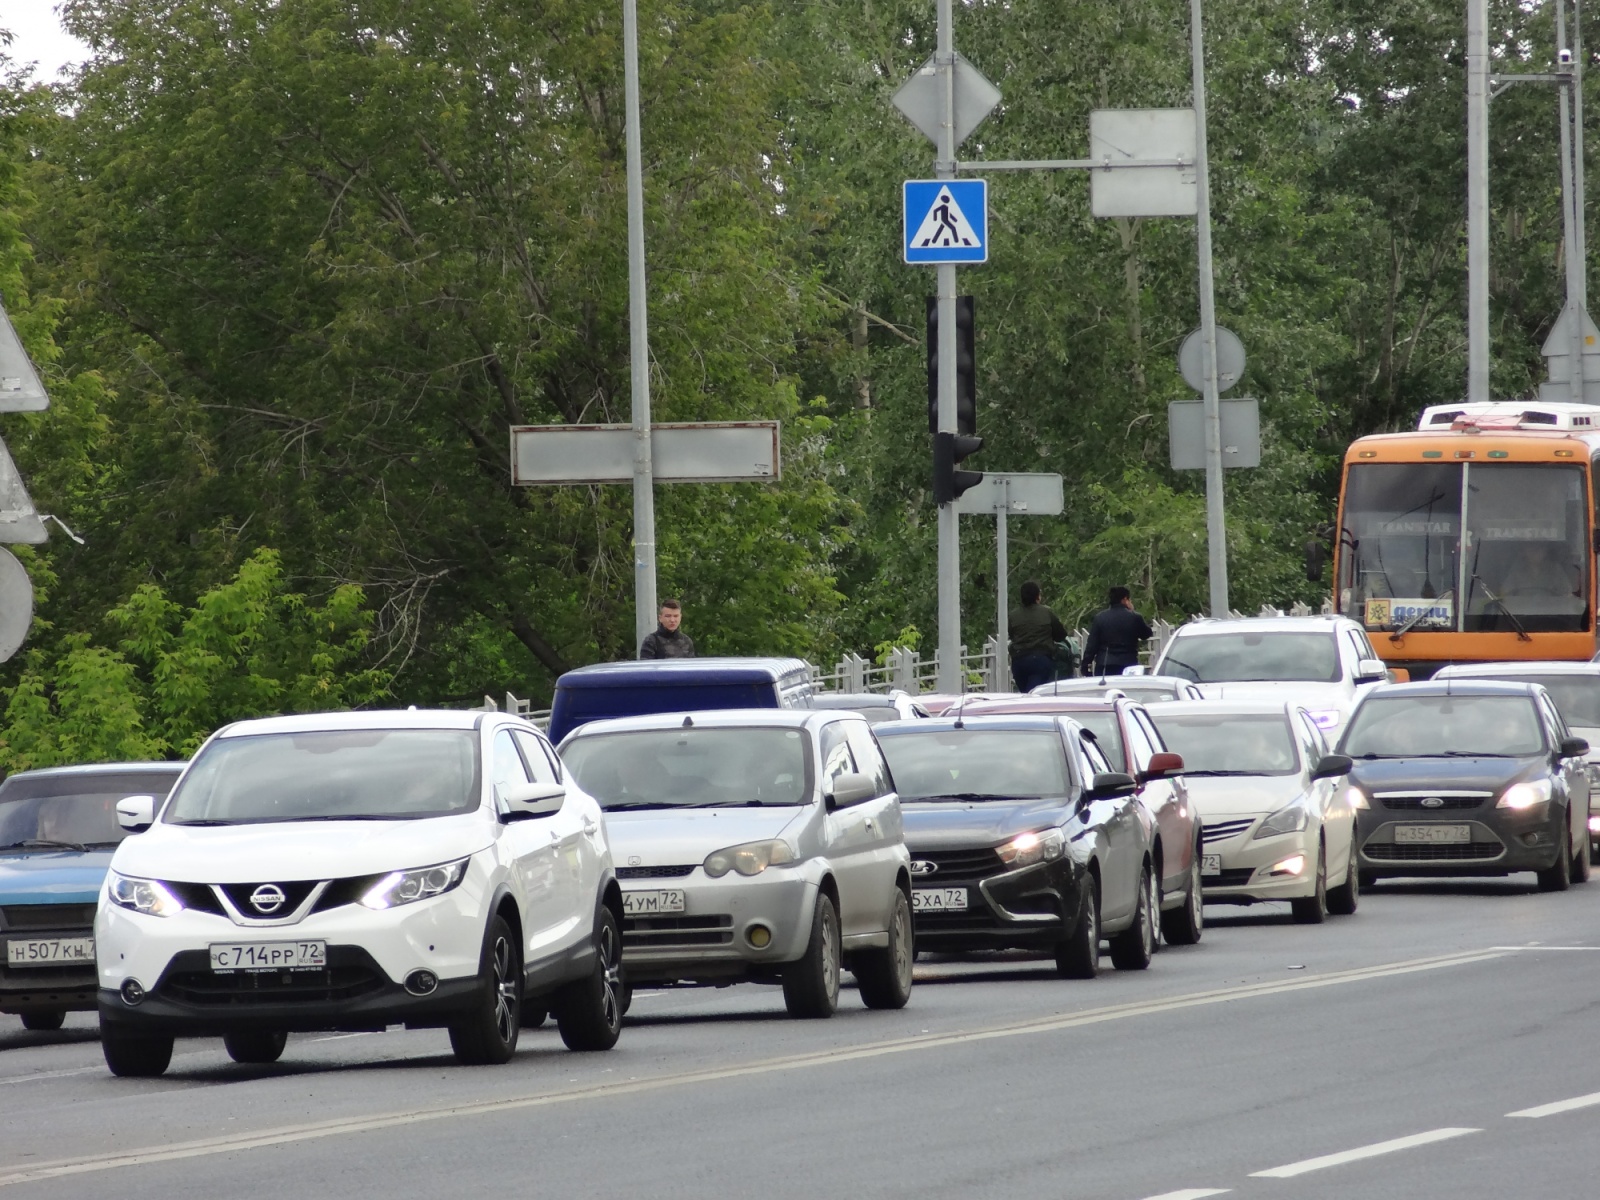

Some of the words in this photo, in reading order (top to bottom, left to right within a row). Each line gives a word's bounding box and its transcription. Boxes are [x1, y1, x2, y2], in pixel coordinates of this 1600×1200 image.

[661, 892, 678, 905] 72
[946, 890, 962, 902] 72
[15, 942, 83, 960] Н507КН
[218, 946, 294, 966] С714РР
[299, 944, 318, 958] 72
